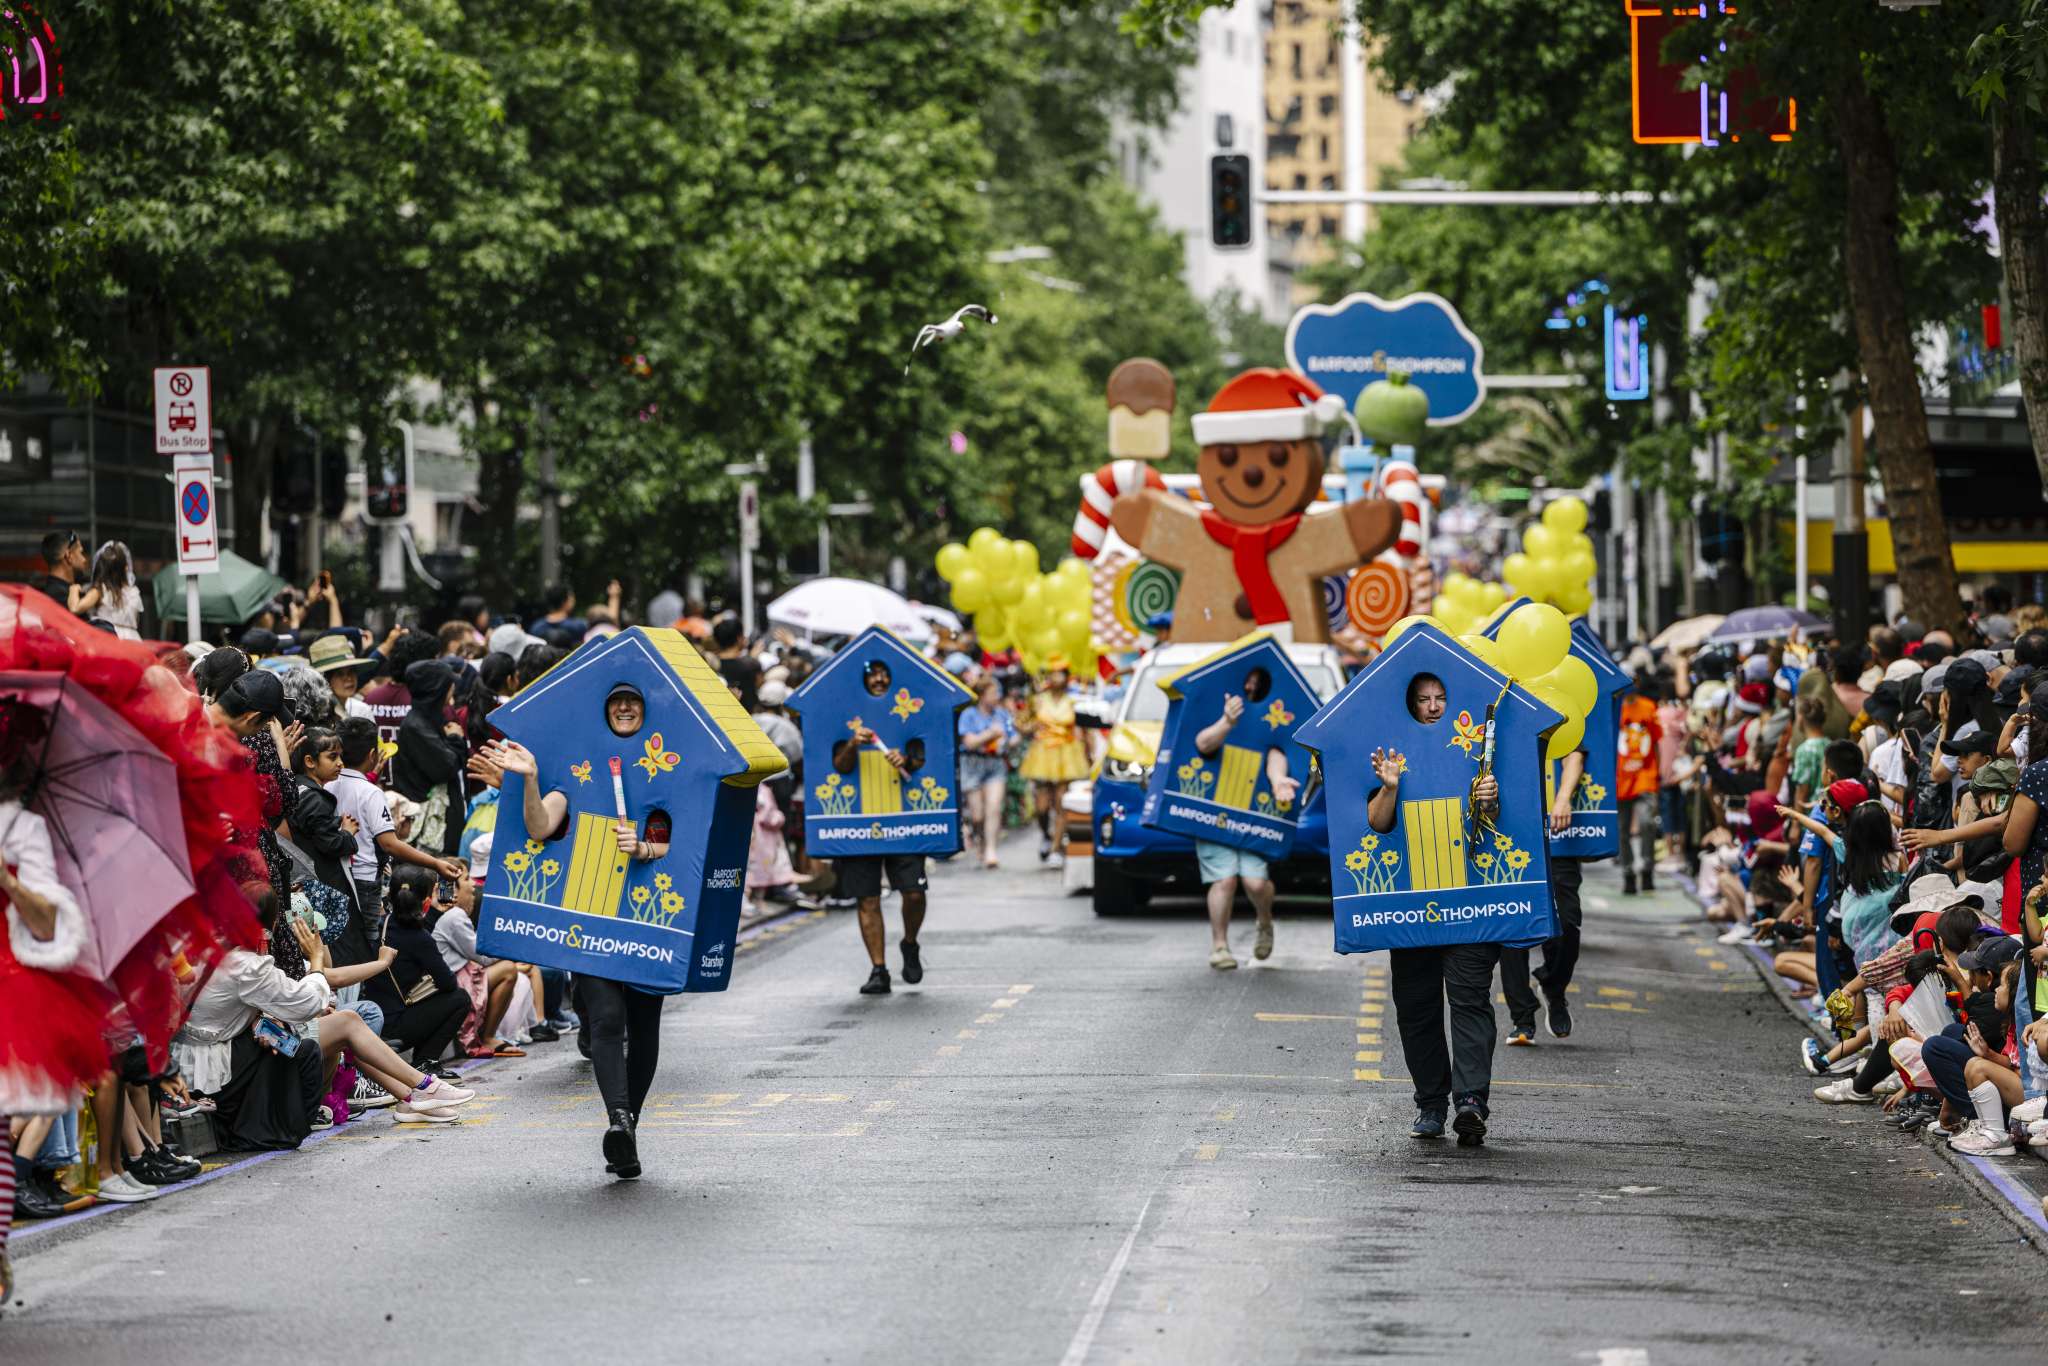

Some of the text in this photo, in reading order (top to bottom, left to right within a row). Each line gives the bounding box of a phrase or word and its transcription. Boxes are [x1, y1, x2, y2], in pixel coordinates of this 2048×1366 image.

[160, 435, 207, 448] Bus Stop
[382, 805, 391, 822] 4
[701, 955, 724, 970] Starship
